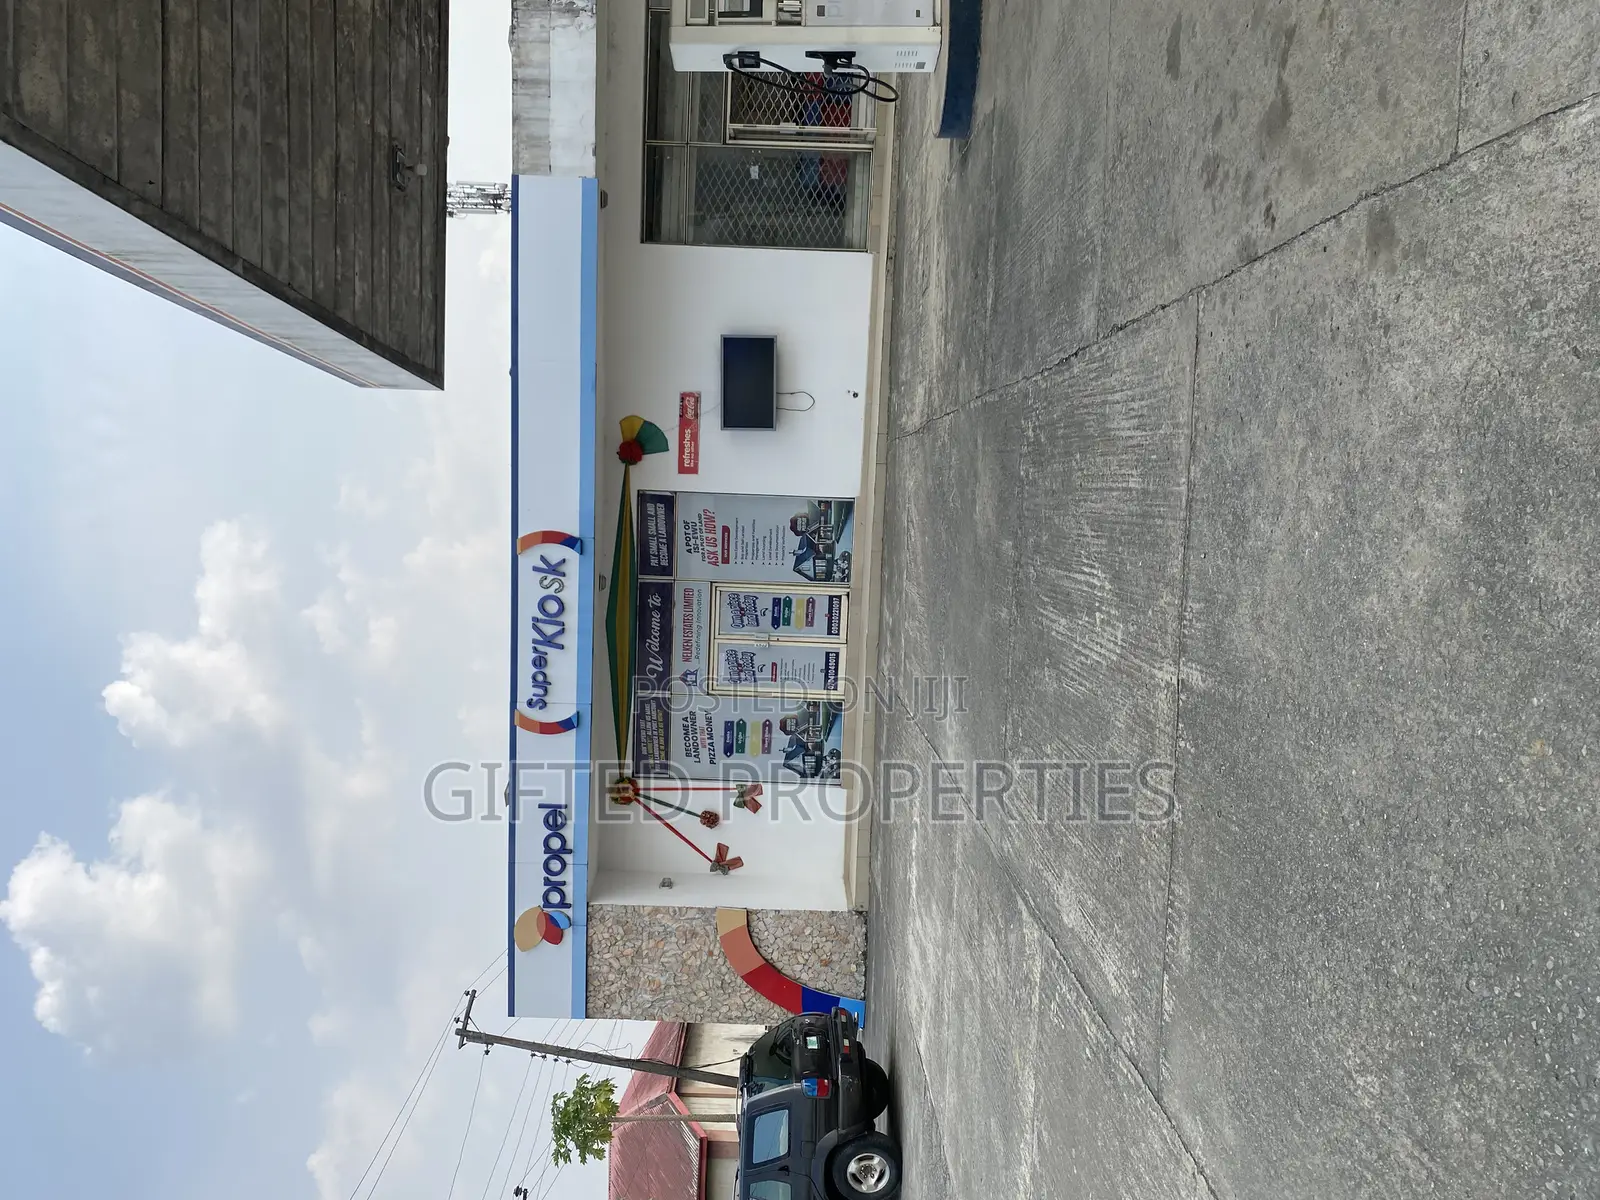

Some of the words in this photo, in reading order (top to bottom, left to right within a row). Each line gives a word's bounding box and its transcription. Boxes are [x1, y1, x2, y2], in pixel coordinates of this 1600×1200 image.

[682, 429, 691, 467] refreshes
[647, 503, 655, 516] AND
[648, 516, 656, 535] SMALL
[656, 503, 666, 538] LANDOWNER
[683, 520, 690, 530] OF
[703, 508, 716, 534] HOW?
[649, 537, 658, 554] SMALL
[690, 521, 700, 553] ISI-EWU
[705, 536, 717, 548] US
[650, 555, 659, 566] PAY
[659, 543, 669, 566] BECOME
[706, 550, 720, 566] ASK
[647, 593, 661, 608] to
[684, 588, 694, 612] LIMITED
[727, 593, 741, 609] piece
[742, 595, 759, 613] today
[683, 614, 693, 638] ESTATES
[730, 615, 744, 628] Own
[746, 614, 760, 627] land
[645, 610, 664, 678] Welcome
[682, 639, 693, 662] NELKEN
[725, 649, 738, 665] piece
[740, 651, 756, 669] today
[728, 671, 740, 684] Own
[743, 670, 756, 682] land
[705, 710, 713, 740] MONEY
[683, 724, 692, 757] BECOME
[689, 711, 700, 763] LANDOWNER
[707, 742, 716, 764] PIZZA
[536, 803, 572, 909] propel
